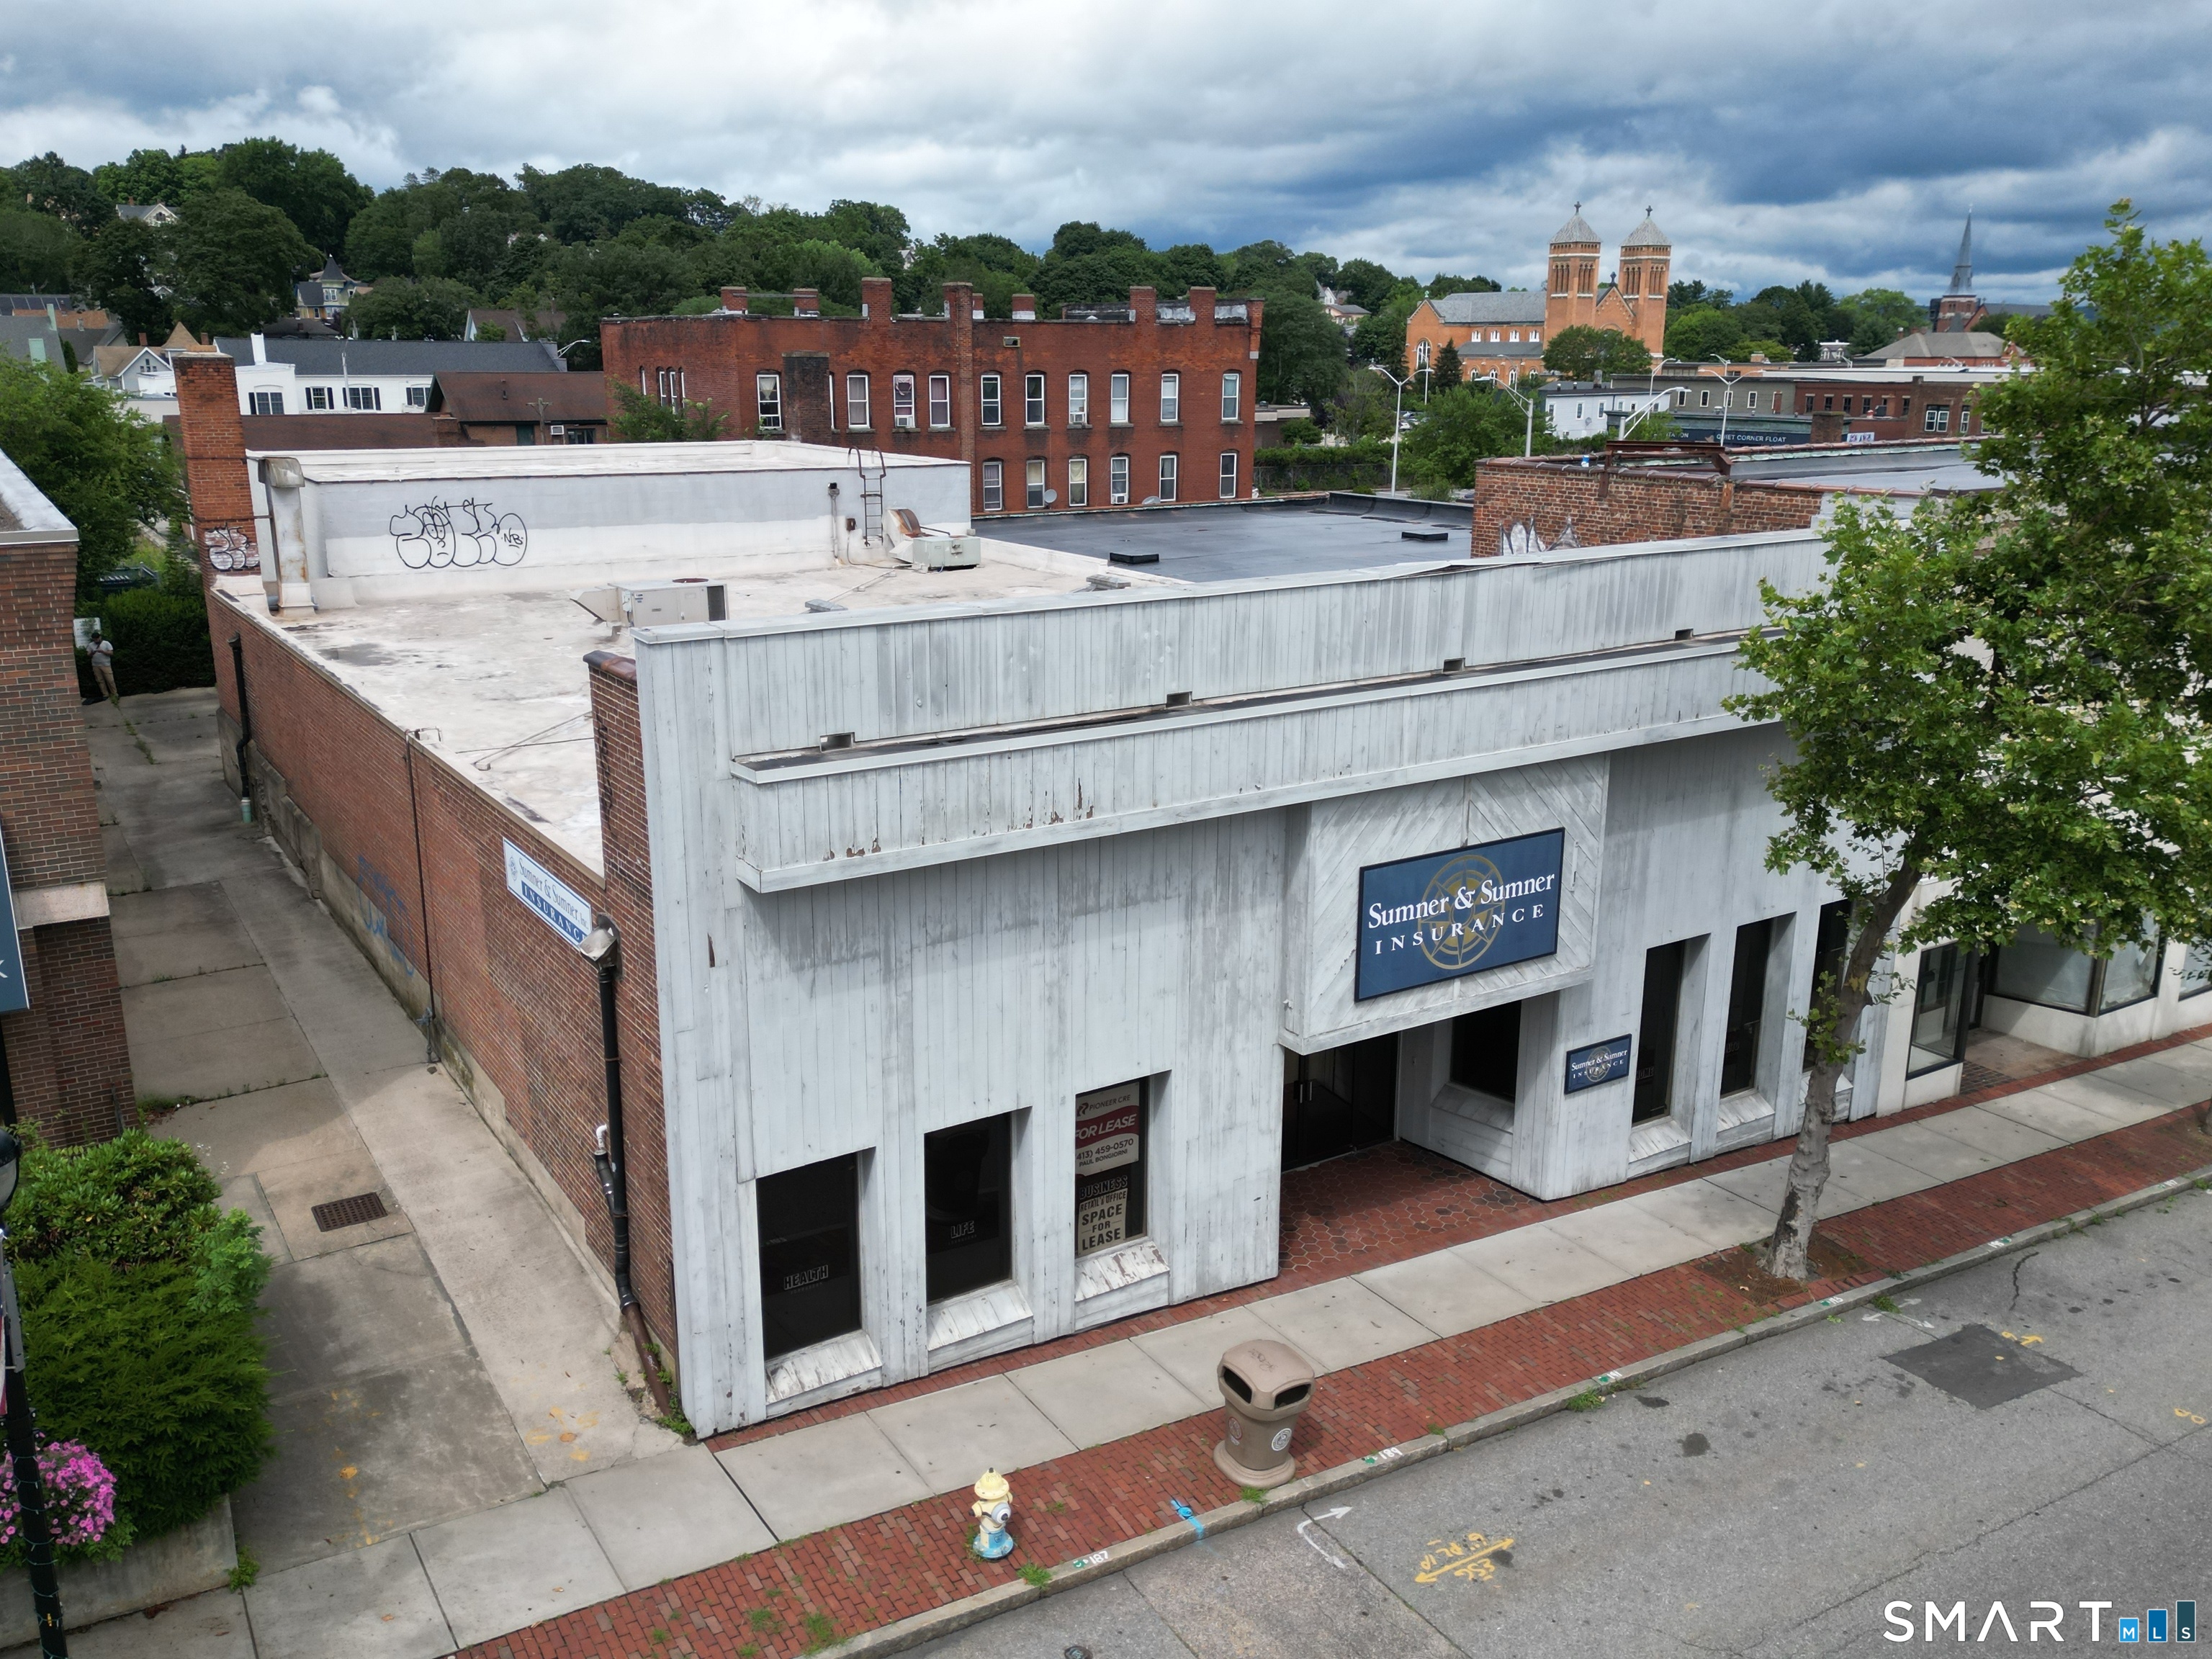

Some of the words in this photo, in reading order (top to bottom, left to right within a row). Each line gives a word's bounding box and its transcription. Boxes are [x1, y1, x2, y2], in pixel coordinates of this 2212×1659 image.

[518, 858, 542, 892] Sumner
[544, 879, 552, 899] &
[1368, 896, 1449, 929] Sumner
[1454, 886, 1476, 910] &
[1480, 873, 1555, 905] Sumner
[1375, 904, 1544, 956] INSURANCE
[1571, 1059, 1595, 1071] Sumner
[1604, 1050, 1627, 1061] Sumner
[1573, 1059, 1624, 1079] INSURANCE
[1089, 1098, 1117, 1110] PIONEER
[1118, 1094, 1130, 1103] CRE
[1099, 1113, 1137, 1136] LEASE
[1095, 1138, 1133, 1155] 459-0570
[1079, 1159, 1094, 1167] PAUL
[1095, 1148, 1128, 1162] BONGIORNI
[1079, 1175, 1128, 1200] BUSINESS
[1080, 1198, 1100, 1212] RETAIL
[1105, 1190, 1126, 1204] OFFICE
[1082, 1203, 1122, 1226] SPACE
[950, 1220, 975, 1238] LIFE
[1092, 1220, 1110, 1233] FOR
[1082, 1228, 1120, 1251] LEASE
[783, 1264, 828, 1290] HEALTH
[1378, 1447, 1403, 1460] 189
[1089, 1550, 1108, 1564] 187
